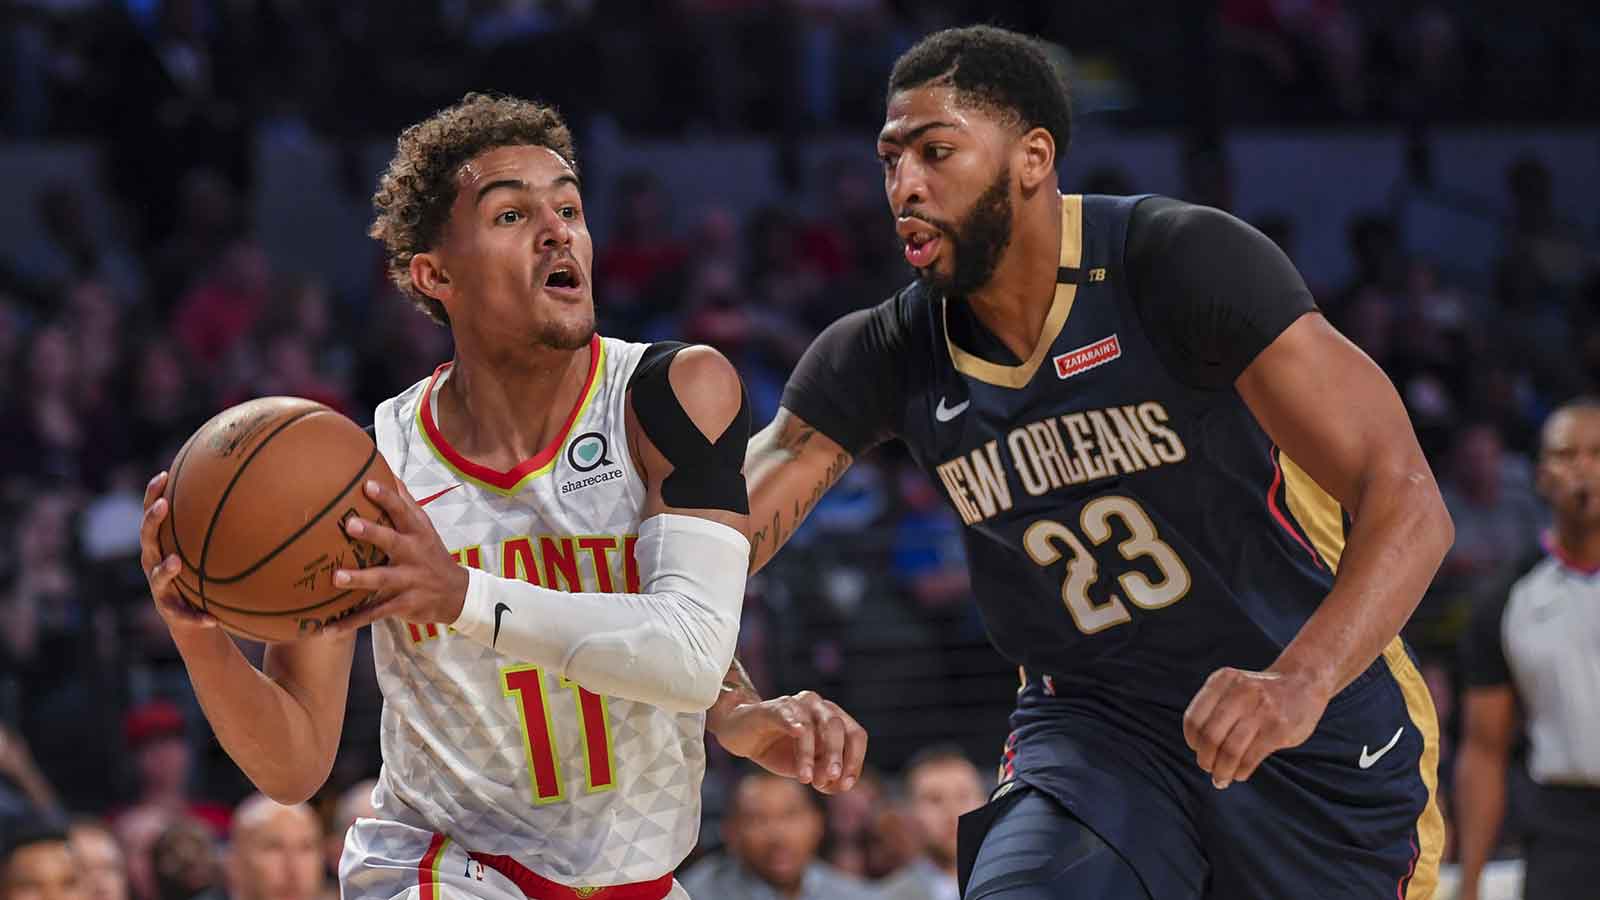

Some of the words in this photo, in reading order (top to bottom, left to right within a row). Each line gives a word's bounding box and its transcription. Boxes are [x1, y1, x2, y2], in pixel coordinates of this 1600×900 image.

[562, 469, 623, 494] sharecare
[936, 441, 1012, 526] NEW
[1008, 402, 1186, 495] ORLEANS
[1023, 496, 1192, 634] 23
[500, 663, 617, 805] 11
